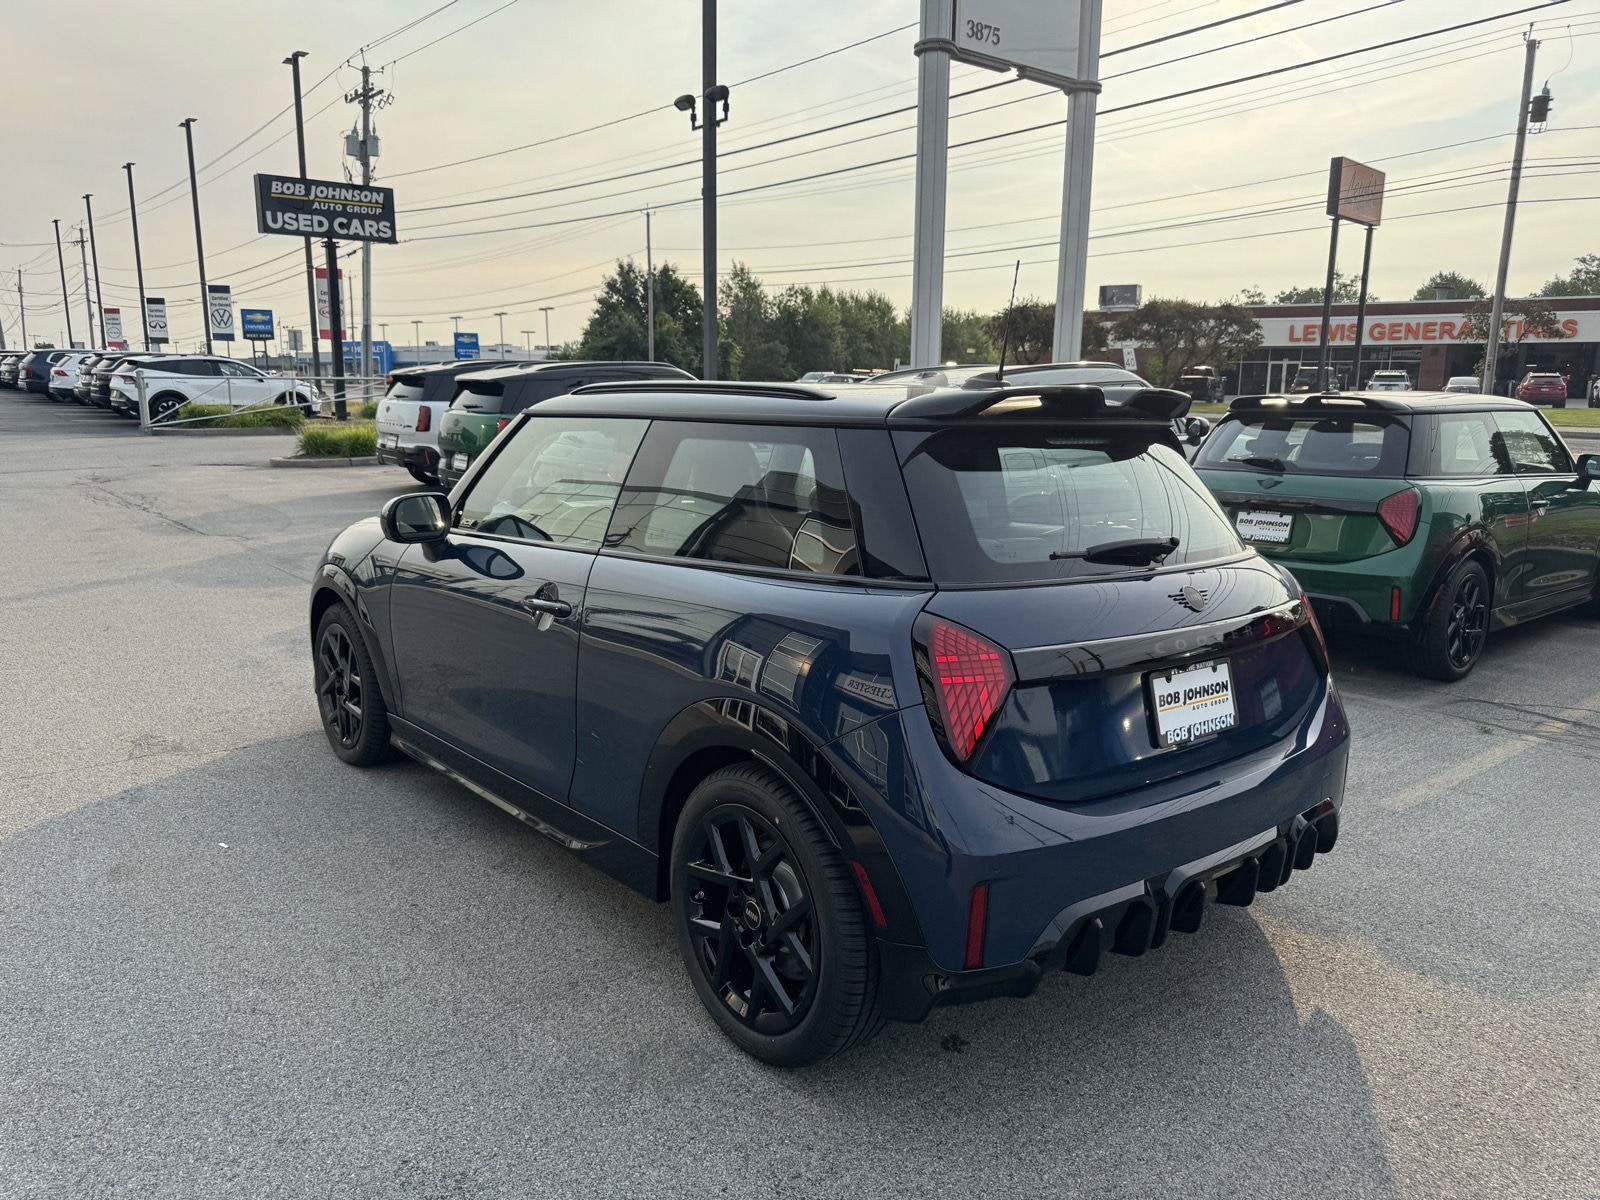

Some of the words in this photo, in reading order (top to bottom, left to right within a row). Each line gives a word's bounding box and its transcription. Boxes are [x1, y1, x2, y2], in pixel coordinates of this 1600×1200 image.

[966, 19, 1000, 45] 3875
[271, 181, 305, 196] BOB
[308, 185, 384, 204] JOHNSON
[312, 202, 342, 211] AUTO
[346, 205, 383, 215] GROUP
[266, 211, 329, 233] USED
[333, 217, 392, 238] CARS
[1369, 319, 1476, 341] GENERA
[1254, 519, 1290, 528] JOHNSON
[1252, 533, 1285, 543] JOHNSON
[1156, 625, 1252, 653] COOPER
[1264, 619, 1272, 636] S
[1158, 691, 1181, 708] BOB
[1182, 680, 1229, 705] JOHNSON
[1191, 702, 1208, 711] AUTO
[1210, 697, 1229, 707] GROUP
[1166, 725, 1189, 744] BOB
[1189, 713, 1235, 742] JOHNSON
